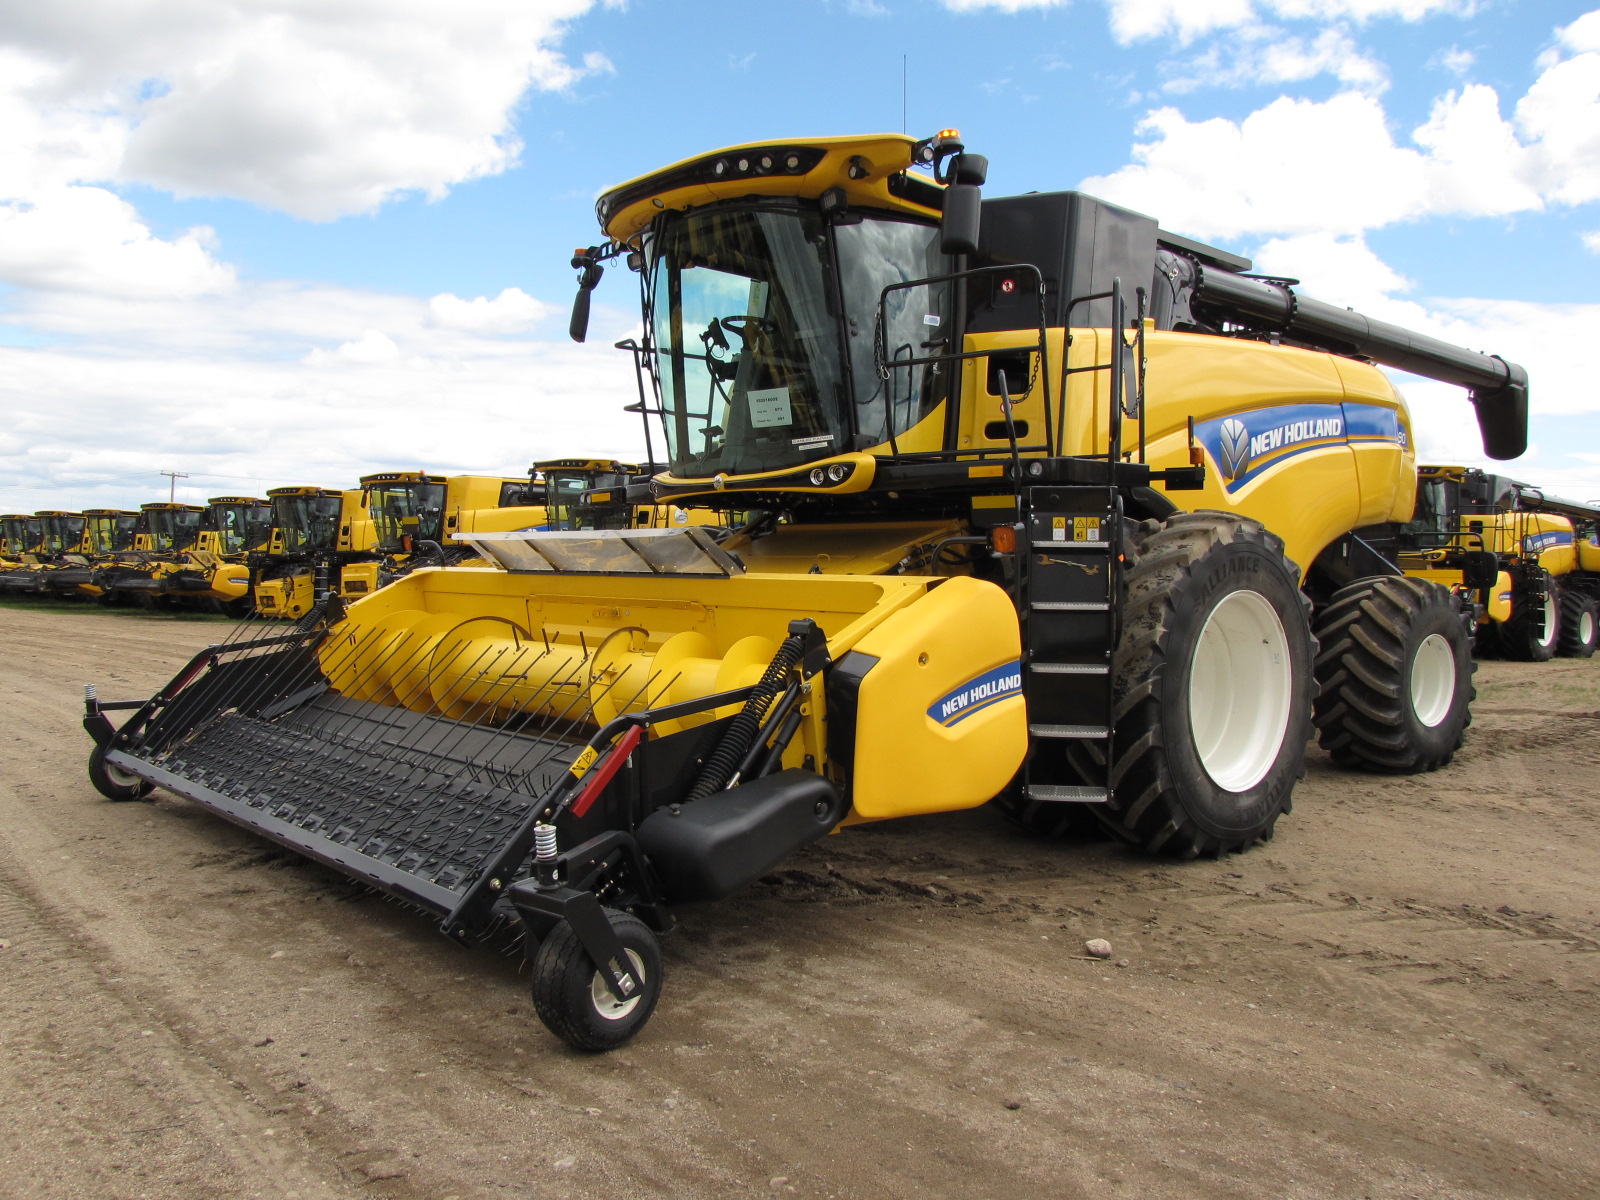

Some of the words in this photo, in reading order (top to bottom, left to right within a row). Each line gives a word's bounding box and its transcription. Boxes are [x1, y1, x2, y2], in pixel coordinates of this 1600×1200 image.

[1250, 427, 1284, 458] NEW
[1284, 418, 1341, 444] HOLLAND
[1199, 556, 1261, 606] ALLIANCE
[942, 691, 969, 718] NEW
[970, 674, 1021, 703] HOLLAND
